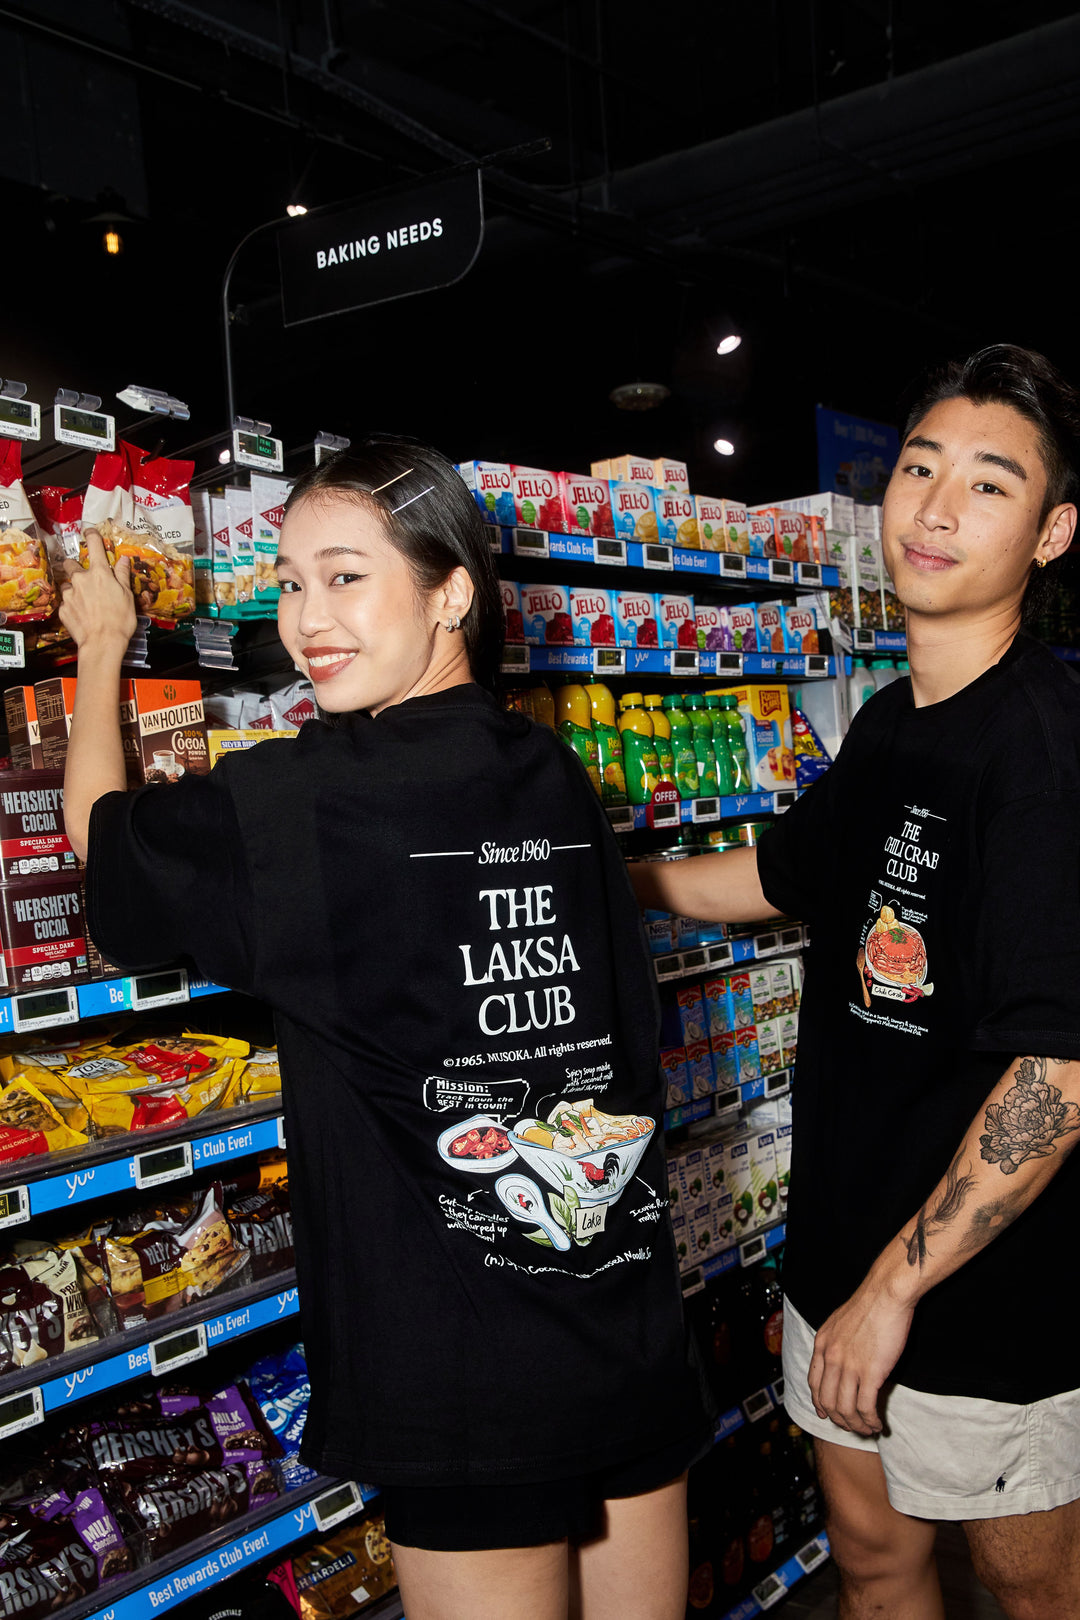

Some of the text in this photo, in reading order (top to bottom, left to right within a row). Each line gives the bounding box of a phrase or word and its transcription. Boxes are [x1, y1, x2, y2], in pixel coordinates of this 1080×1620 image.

[316, 217, 443, 269] BAKING NEEDS
[548, 652, 588, 665] Best Rewards
[141, 703, 203, 729] VAN HOUTEN
[221, 741, 242, 749] SILVER
[654, 790, 678, 802] OFFER
[21, 812, 58, 833] COCOA
[900, 820, 922, 843] THE
[20, 838, 46, 847] SPECIAL
[477, 838, 550, 865] Since 1960
[884, 835, 940, 870] CHILI CRAB
[886, 858, 918, 883] CLUB
[15, 892, 80, 922] HERSHEY'S
[479, 884, 557, 931] THE
[33, 917, 70, 940] COCOA
[32, 941, 75, 954] SPECIAL DARK
[458, 934, 581, 986] LAKSA
[478, 985, 576, 1036] CLUB
[487, 1048, 533, 1063] MUSOKA.
[533, 1047, 547, 1059] All
[548, 1043, 576, 1058] rights
[576, 1034, 613, 1050] reserved.
[565, 1067, 583, 1081] Spicy
[596, 1061, 611, 1072] made
[436, 1079, 489, 1093] Mission:
[437, 1099, 507, 1110] BEST in town!
[202, 1139, 226, 1158] Club
[227, 1131, 253, 1152] Ever!
[65, 1169, 96, 1200] yuu
[448, 1206, 486, 1222] they can
[581, 1212, 602, 1231] Laksa
[497, 1225, 508, 1238] up
[207, 1309, 250, 1339] lub Ever!
[127, 1350, 151, 1370] Best
[64, 1365, 94, 1398] yuu
[211, 1410, 243, 1425] MILK
[215, 1421, 246, 1432] chocolate
[91, 1418, 217, 1471] HERSHEY'S
[82, 1515, 114, 1543] MILK
[148, 1531, 270, 1608] Best Rewards Club Ever!
